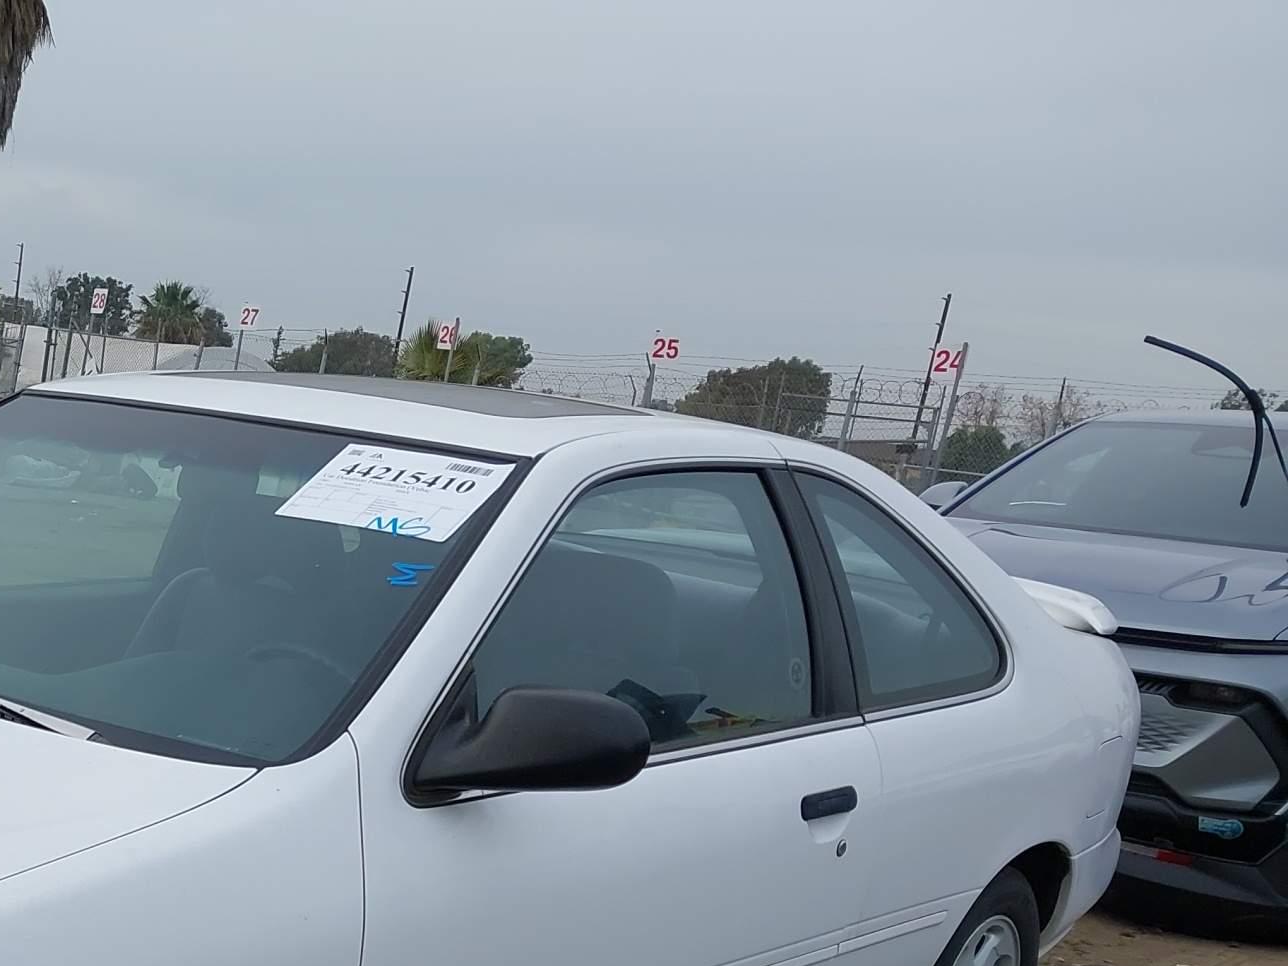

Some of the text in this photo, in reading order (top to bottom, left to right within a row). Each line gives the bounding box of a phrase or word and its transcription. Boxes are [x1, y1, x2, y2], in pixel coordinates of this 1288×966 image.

[92, 292, 106, 309] 28
[240, 307, 259, 326] 27
[652, 338, 679, 359] 25
[934, 350, 963, 372] 24
[340, 462, 477, 494] 44215410
